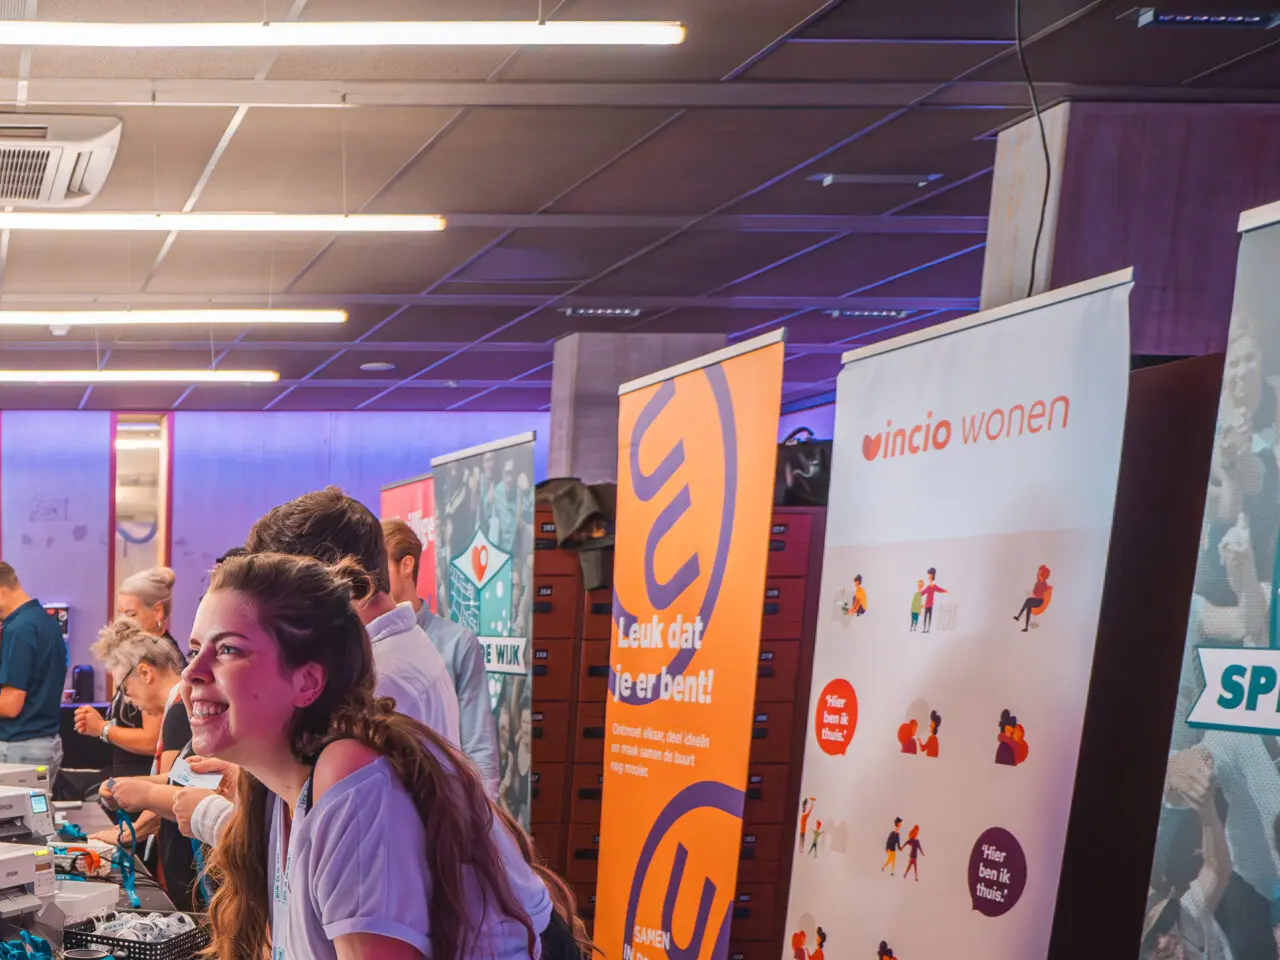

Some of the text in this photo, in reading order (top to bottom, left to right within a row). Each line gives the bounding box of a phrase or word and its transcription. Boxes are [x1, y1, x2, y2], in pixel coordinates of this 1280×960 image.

[962, 395, 1070, 445] wonen
[617, 613, 703, 649] Leuk dat
[496, 643, 520, 666] WIJK
[613, 664, 715, 704] je er bent!
[1216, 664, 1280, 713] SP
[823, 710, 839, 725] ben
[978, 862, 1011, 884] ben ik
[633, 925, 671, 950] SAMEN
